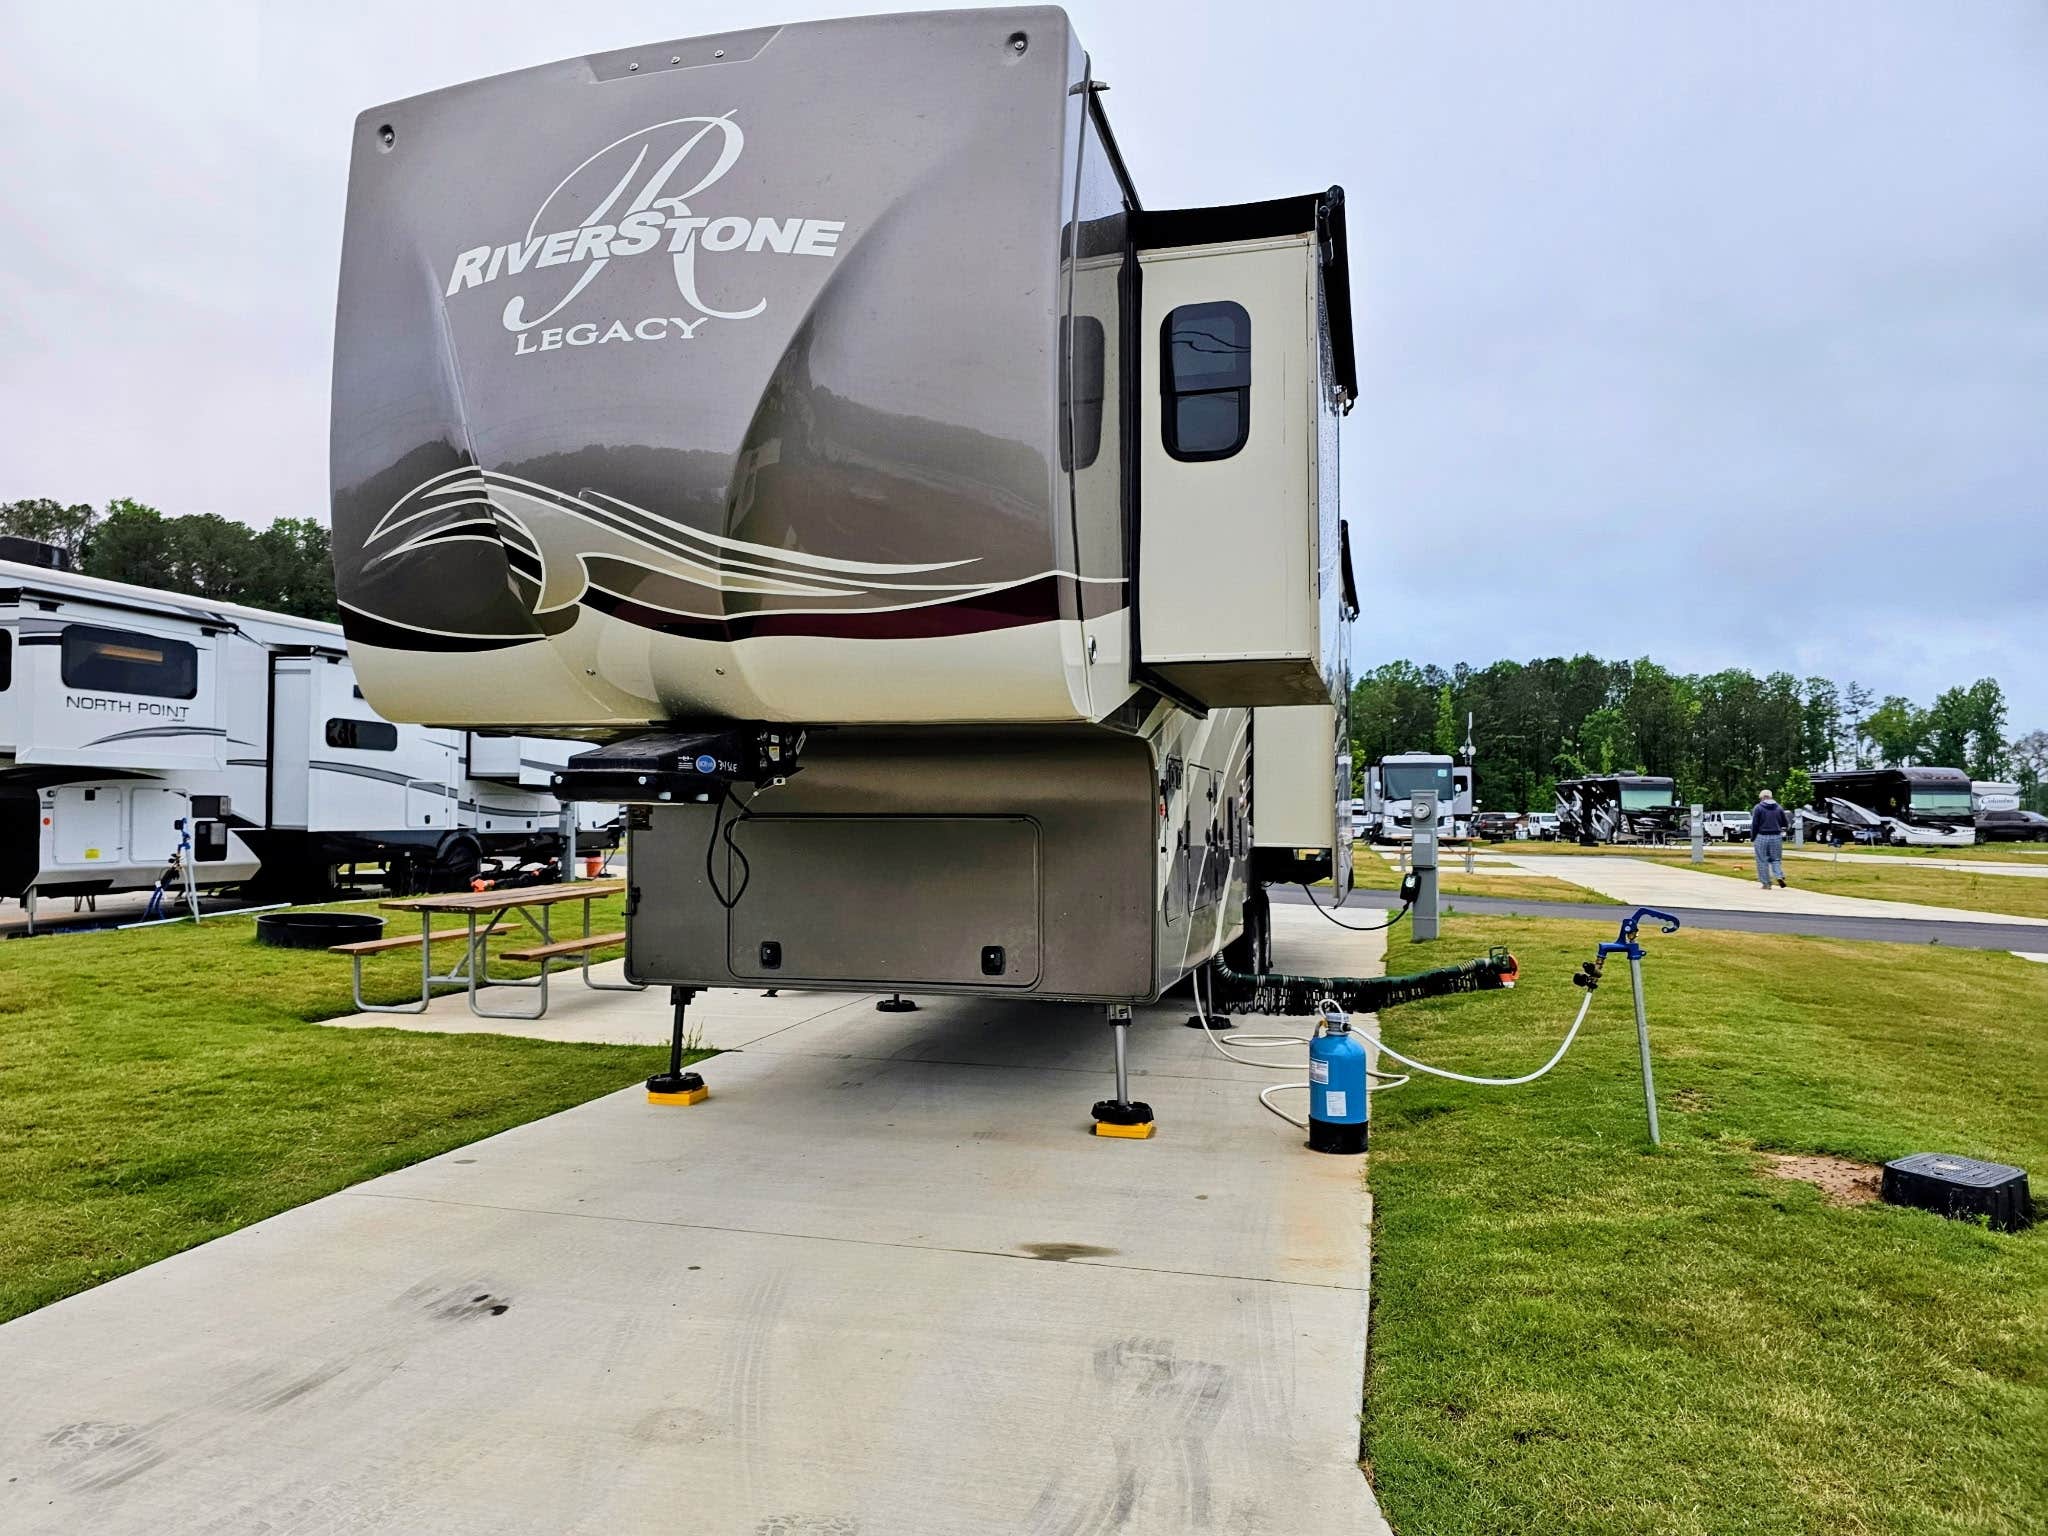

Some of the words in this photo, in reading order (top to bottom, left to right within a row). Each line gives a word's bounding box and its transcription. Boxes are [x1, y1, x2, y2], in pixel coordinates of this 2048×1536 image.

[514, 317, 709, 356] LEGACY
[66, 695, 131, 713] NORTH
[138, 702, 189, 718] POINT
